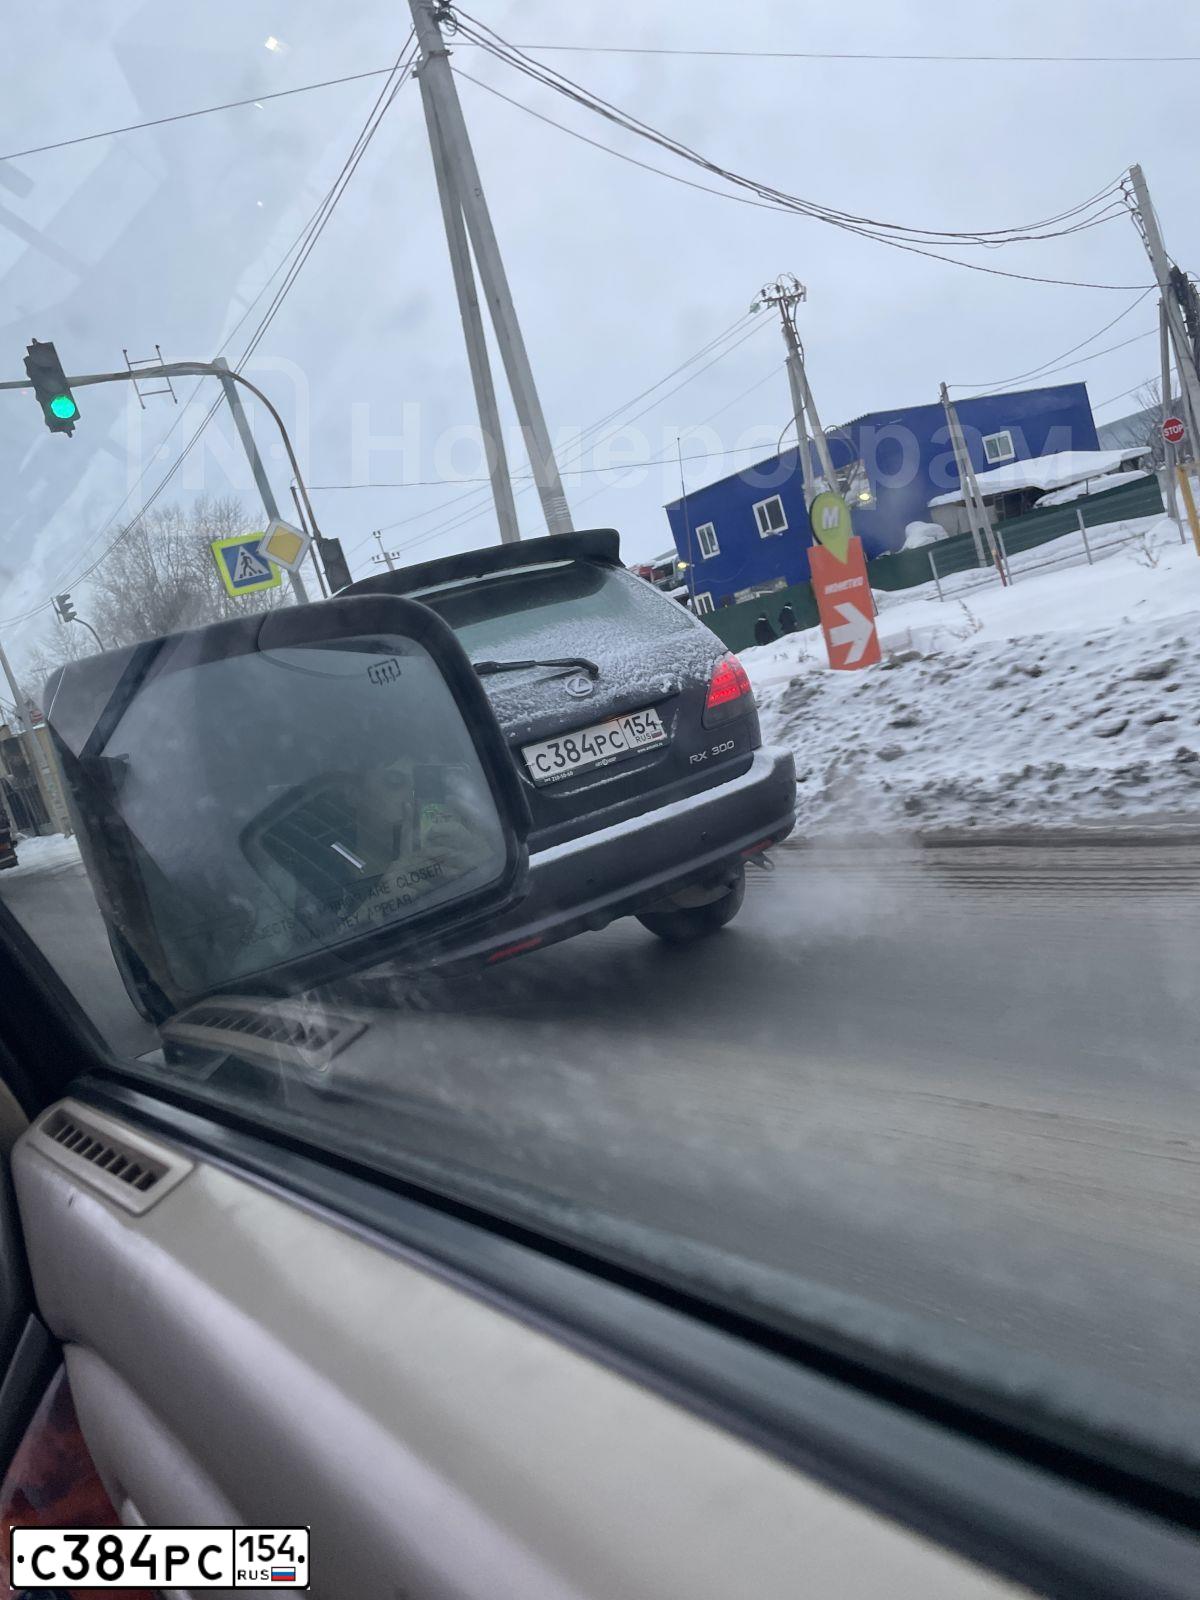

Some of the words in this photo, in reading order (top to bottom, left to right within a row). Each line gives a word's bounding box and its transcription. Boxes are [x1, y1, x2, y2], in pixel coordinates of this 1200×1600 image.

[1163, 424, 1183, 437] STOP
[535, 730, 624, 773] С384РС
[623, 712, 657, 737] 154
[635, 732, 652, 743] RUS
[689, 751, 708, 764] RX
[711, 740, 735, 756] 300
[367, 881, 391, 898] ARE
[396, 863, 444, 889] CLOSER
